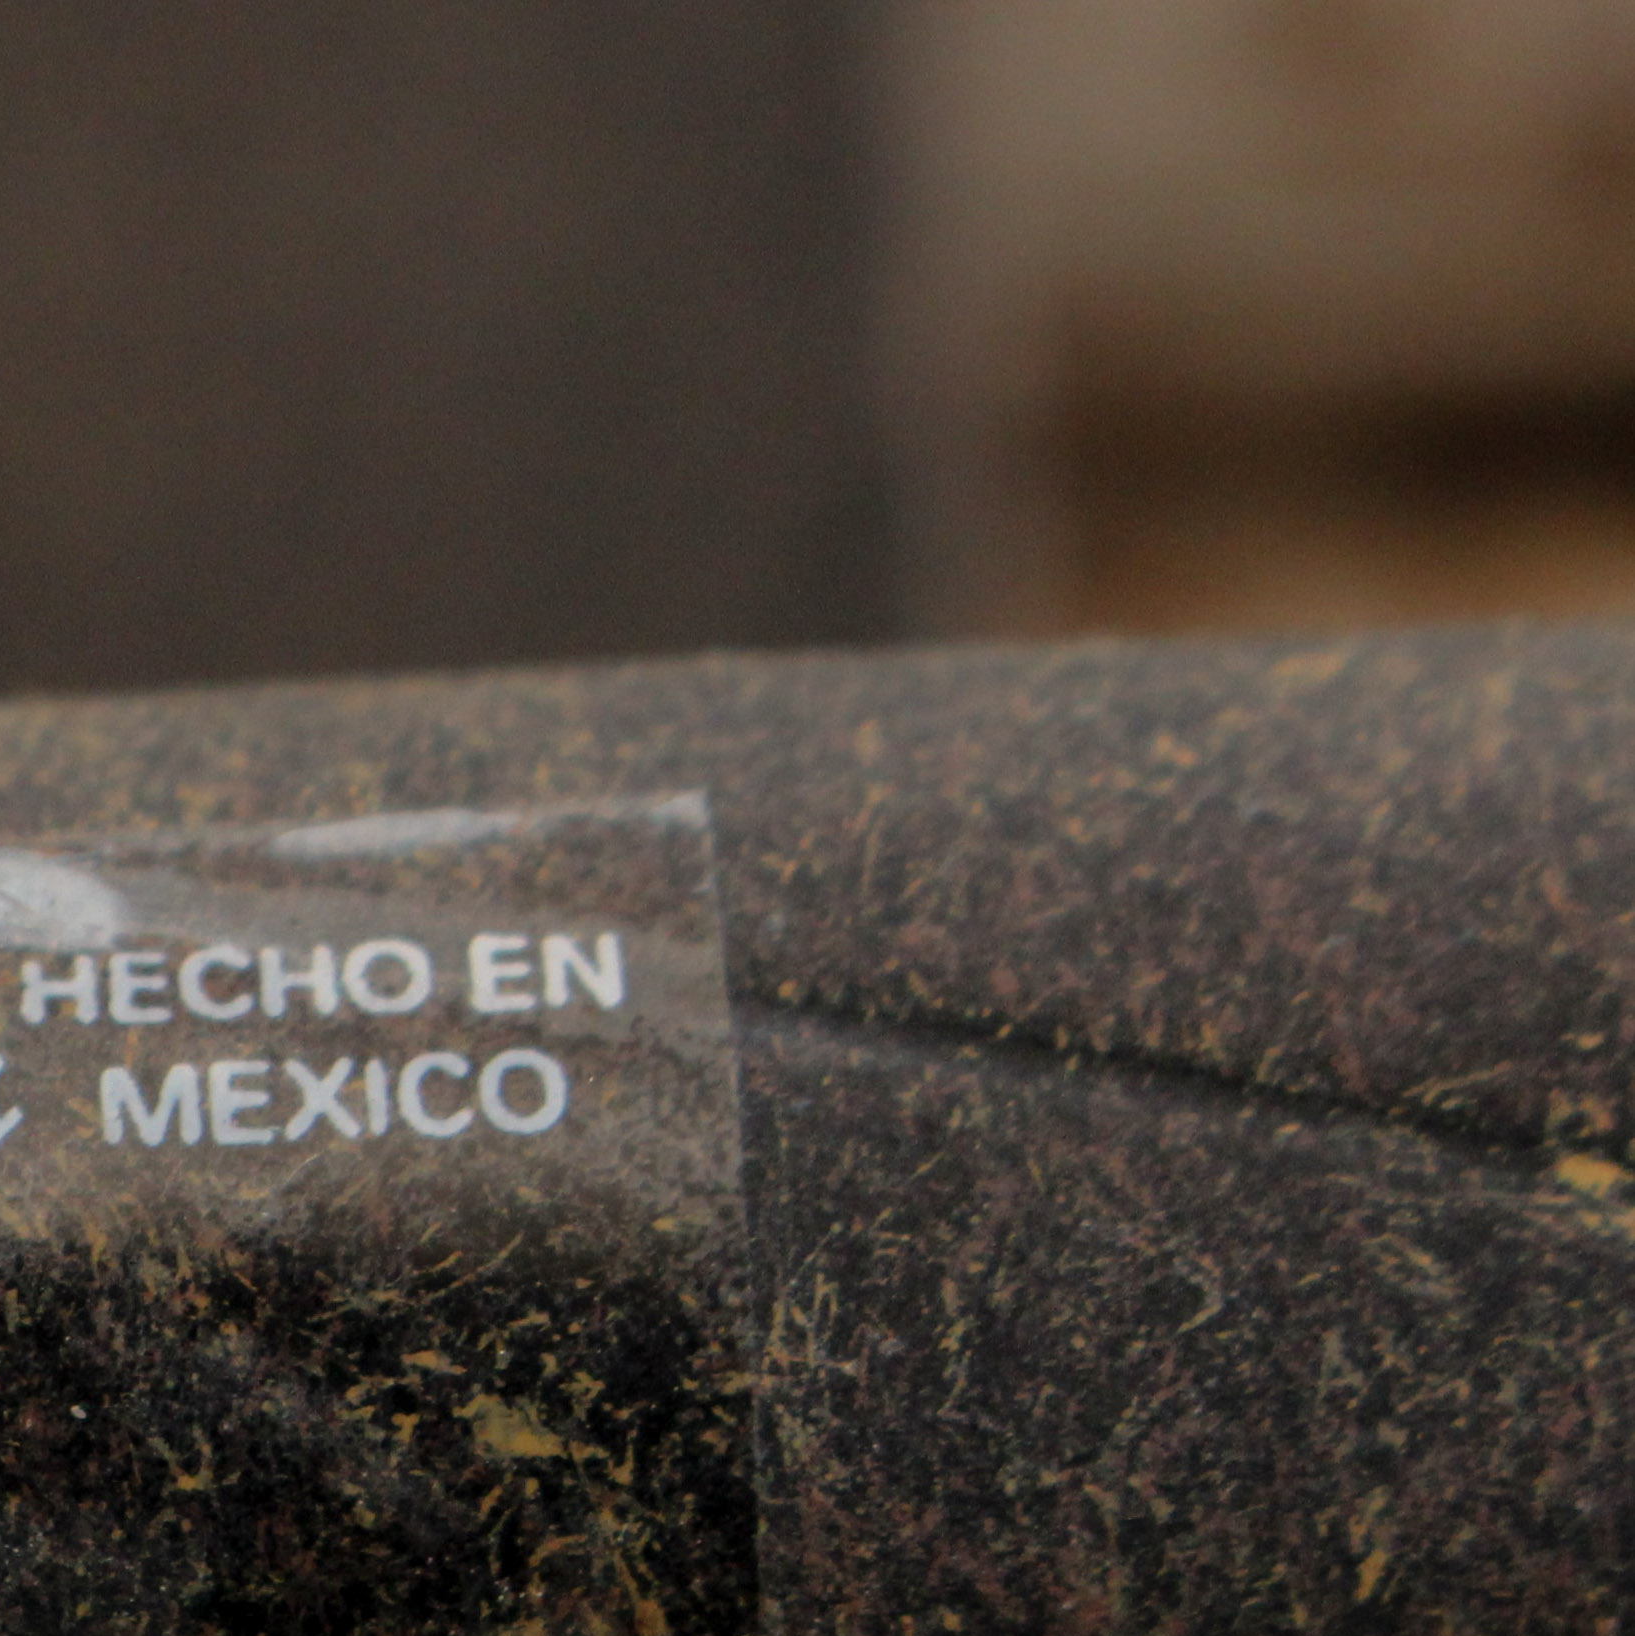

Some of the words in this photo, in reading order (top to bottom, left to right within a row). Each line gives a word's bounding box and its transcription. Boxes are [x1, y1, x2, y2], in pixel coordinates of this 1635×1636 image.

[18, 937, 431, 1025] HECHO
[467, 931, 625, 1014] EN
[99, 1047, 569, 1146] MEXICO
